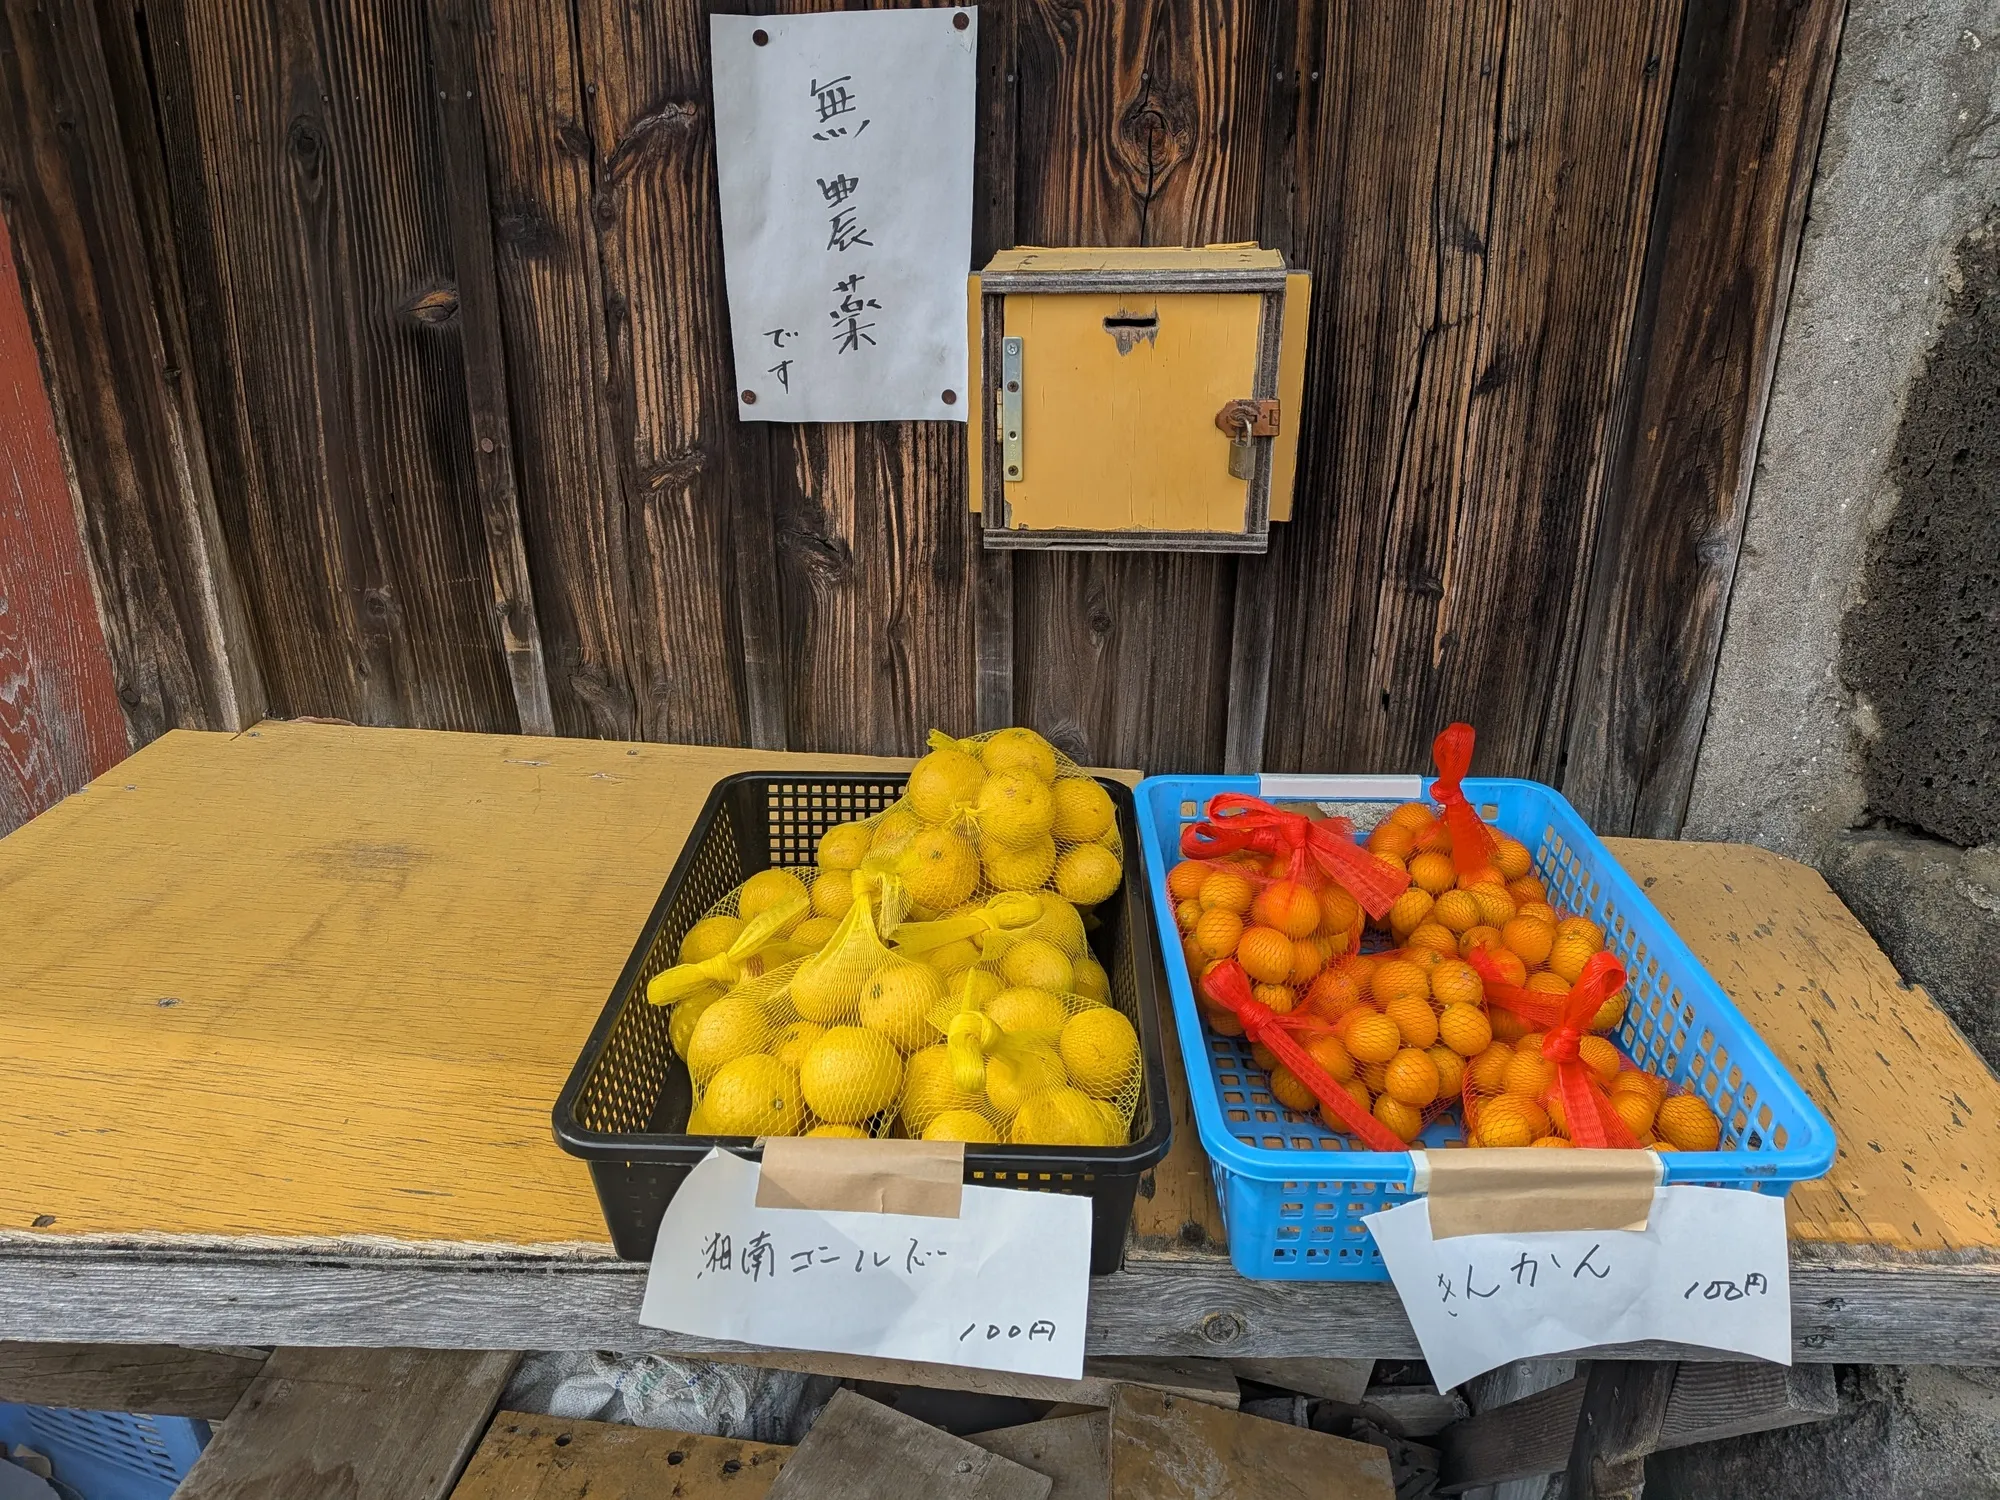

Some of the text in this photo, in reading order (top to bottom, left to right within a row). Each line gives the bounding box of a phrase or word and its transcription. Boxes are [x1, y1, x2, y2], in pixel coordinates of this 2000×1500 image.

[809, 74, 882, 355] 無農薬
[763, 327, 799, 394] です
[697, 1230, 948, 1282] 湘南ゴールド
[1437, 1243, 1768, 1317] きんかん 100円
[958, 1319, 1057, 1342] 100円
